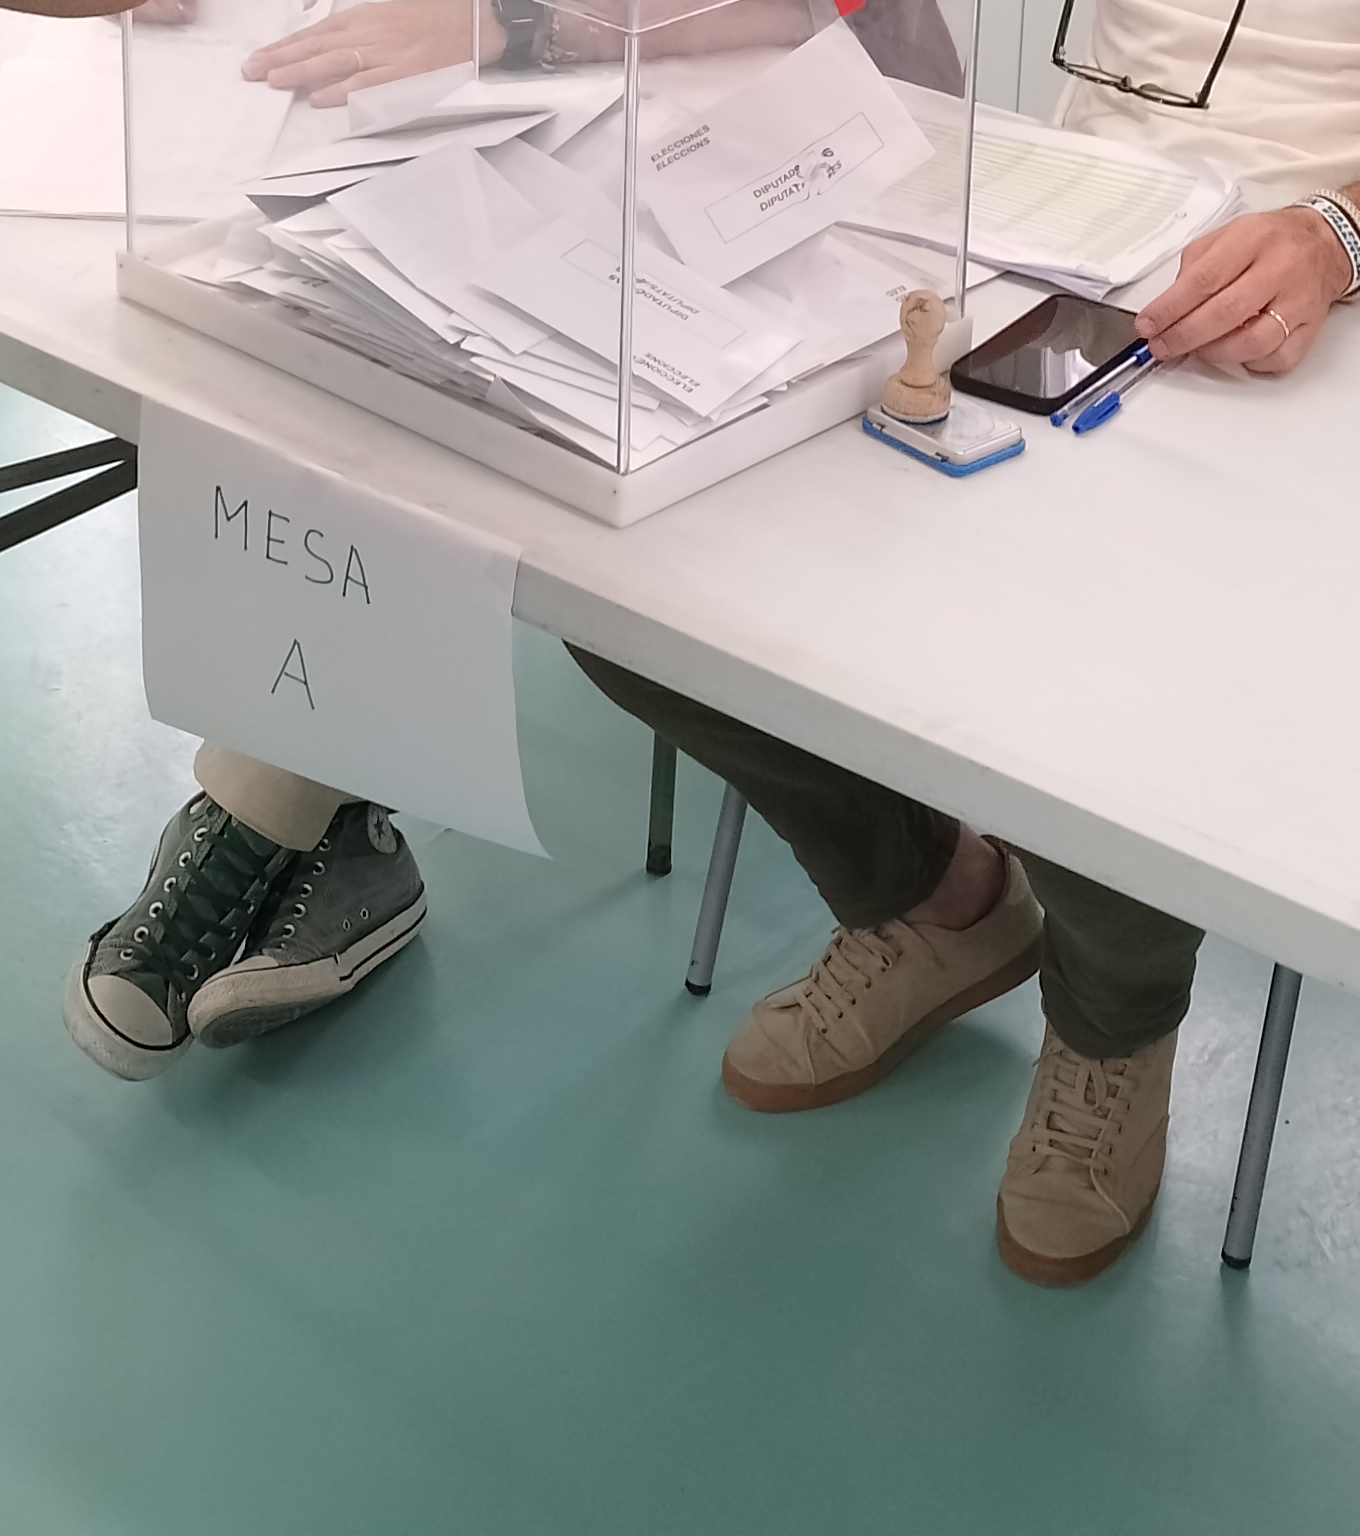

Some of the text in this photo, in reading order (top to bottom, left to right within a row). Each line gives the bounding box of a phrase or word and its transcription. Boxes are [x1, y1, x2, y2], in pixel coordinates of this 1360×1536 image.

[650, 124, 711, 163] ELECCIONES
[655, 136, 711, 172] ELECCIONS
[632, 355, 694, 394] ELECCIONE
[644, 352, 701, 388] ELECCIONS
[213, 484, 371, 605] MESA
[270, 638, 315, 711] A
